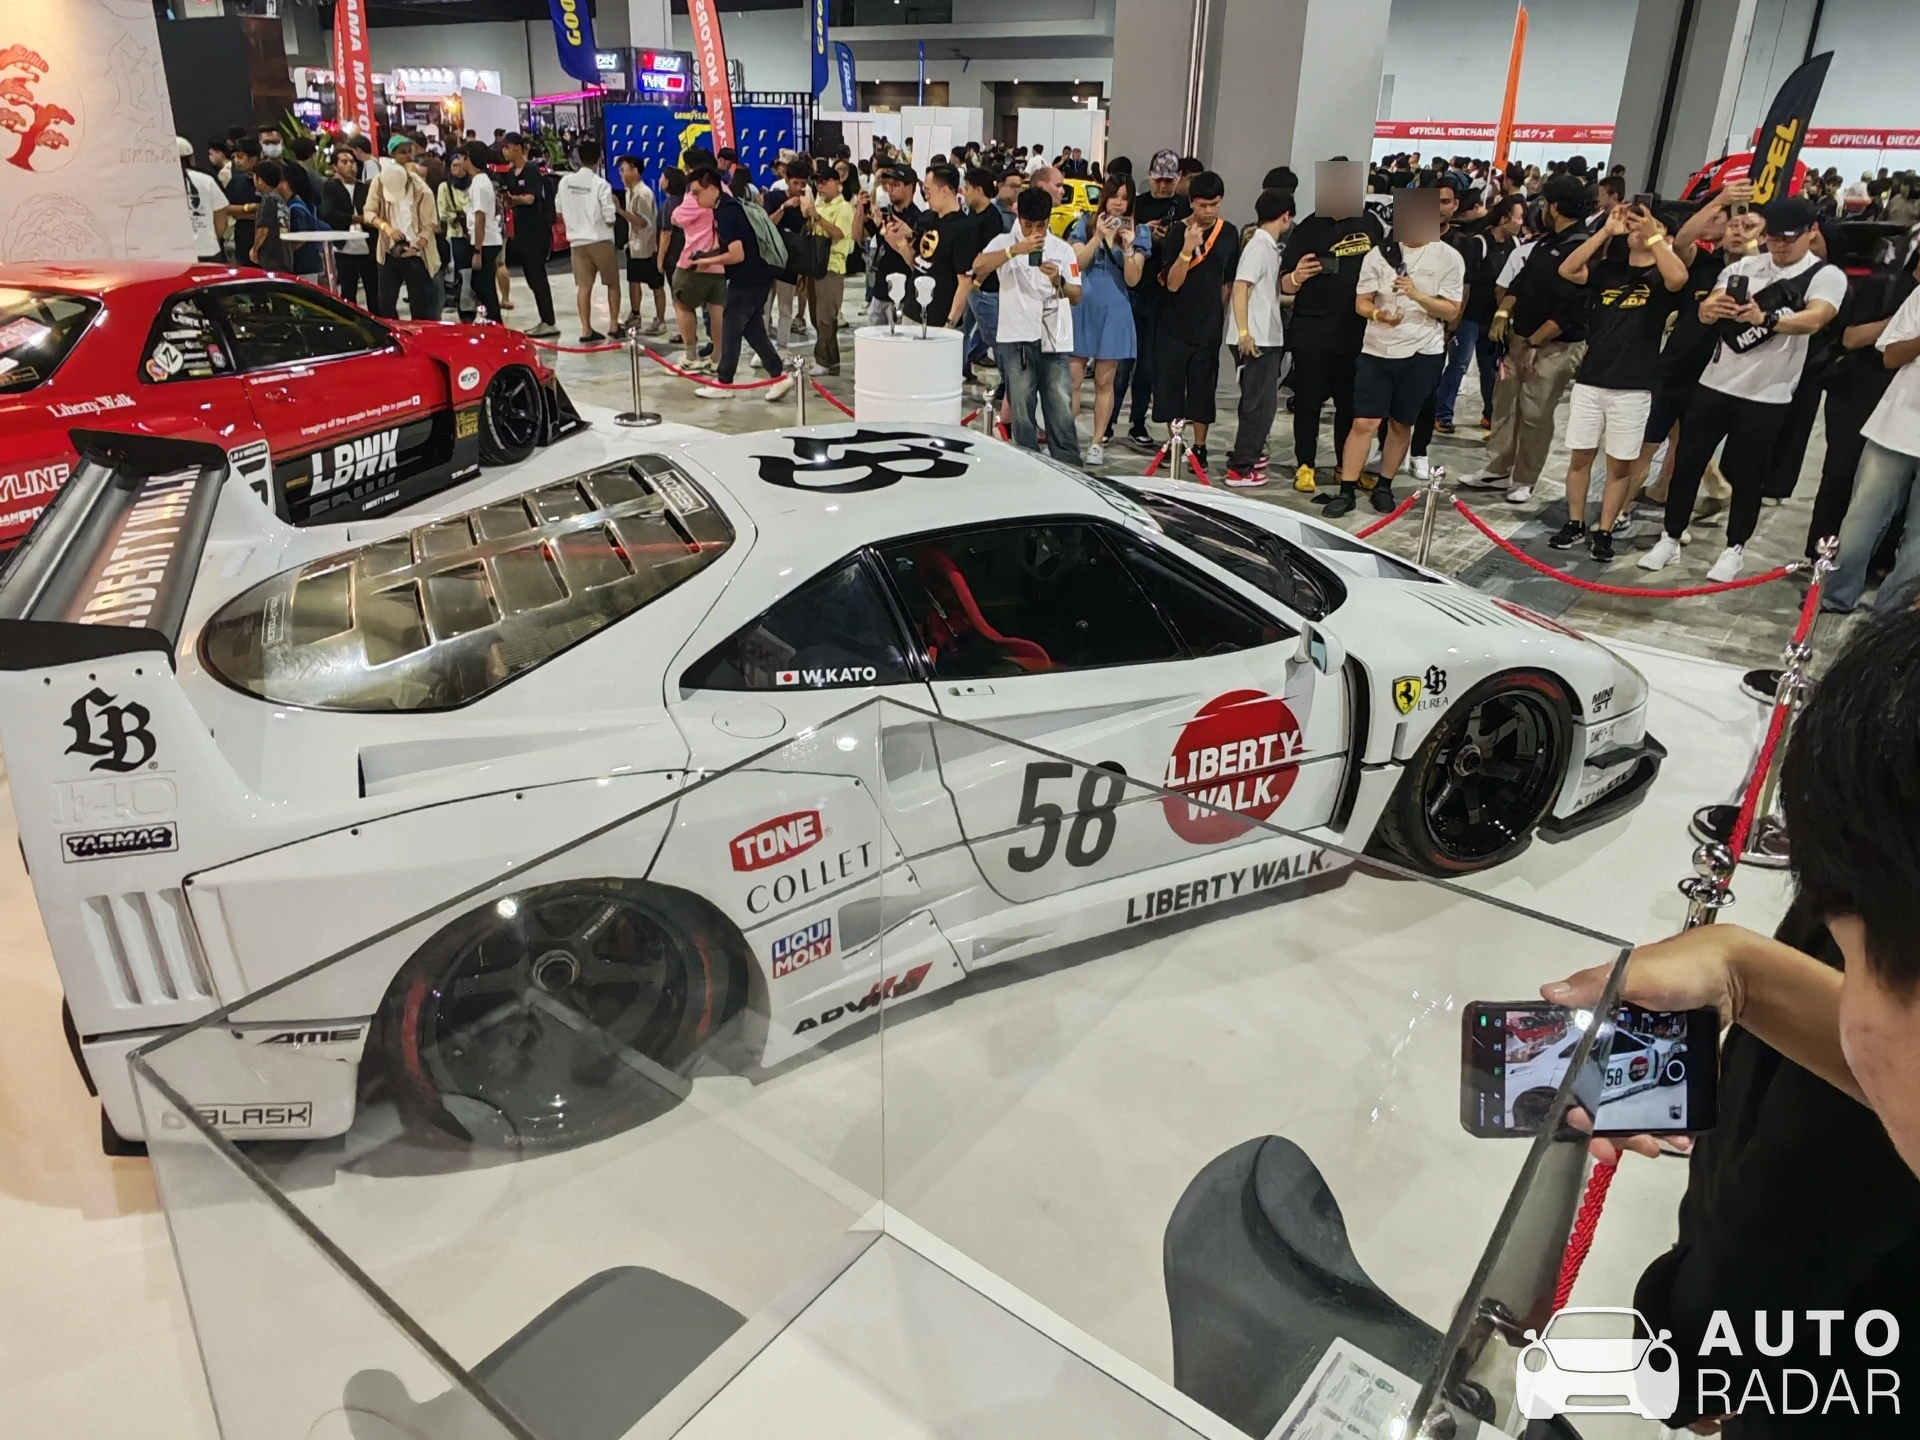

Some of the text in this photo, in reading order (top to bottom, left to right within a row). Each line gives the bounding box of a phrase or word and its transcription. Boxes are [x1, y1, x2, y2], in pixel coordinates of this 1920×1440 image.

[1409, 126, 1495, 138] OFFICIAL MERCHAND
[1513, 128, 1555, 140] 公式グッズ
[1829, 134, 1883, 146] OFFICIAL
[1335, 244, 1371, 258] HONDA
[95, 394, 136, 410] Walk
[310, 428, 399, 496] LBWK
[79, 527, 180, 628] IBERTY
[802, 666, 877, 684] W.KATO
[1591, 684, 1615, 705] MINI
[1592, 698, 1612, 714] GT
[63, 687, 157, 773] LB
[1164, 730, 1301, 788] LIBERTY
[1574, 772, 1629, 809] ATHLETE
[1008, 761, 1127, 872] 58
[66, 827, 172, 857] TARMAC
[737, 815, 817, 865] TONE
[746, 842, 872, 914] COLLET
[1126, 869, 1248, 924] LIBERTY
[775, 920, 831, 957] LIQUI
[775, 938, 831, 978] MOLY
[256, 1028, 362, 1046] AME
[1605, 1068, 1623, 1087] 58
